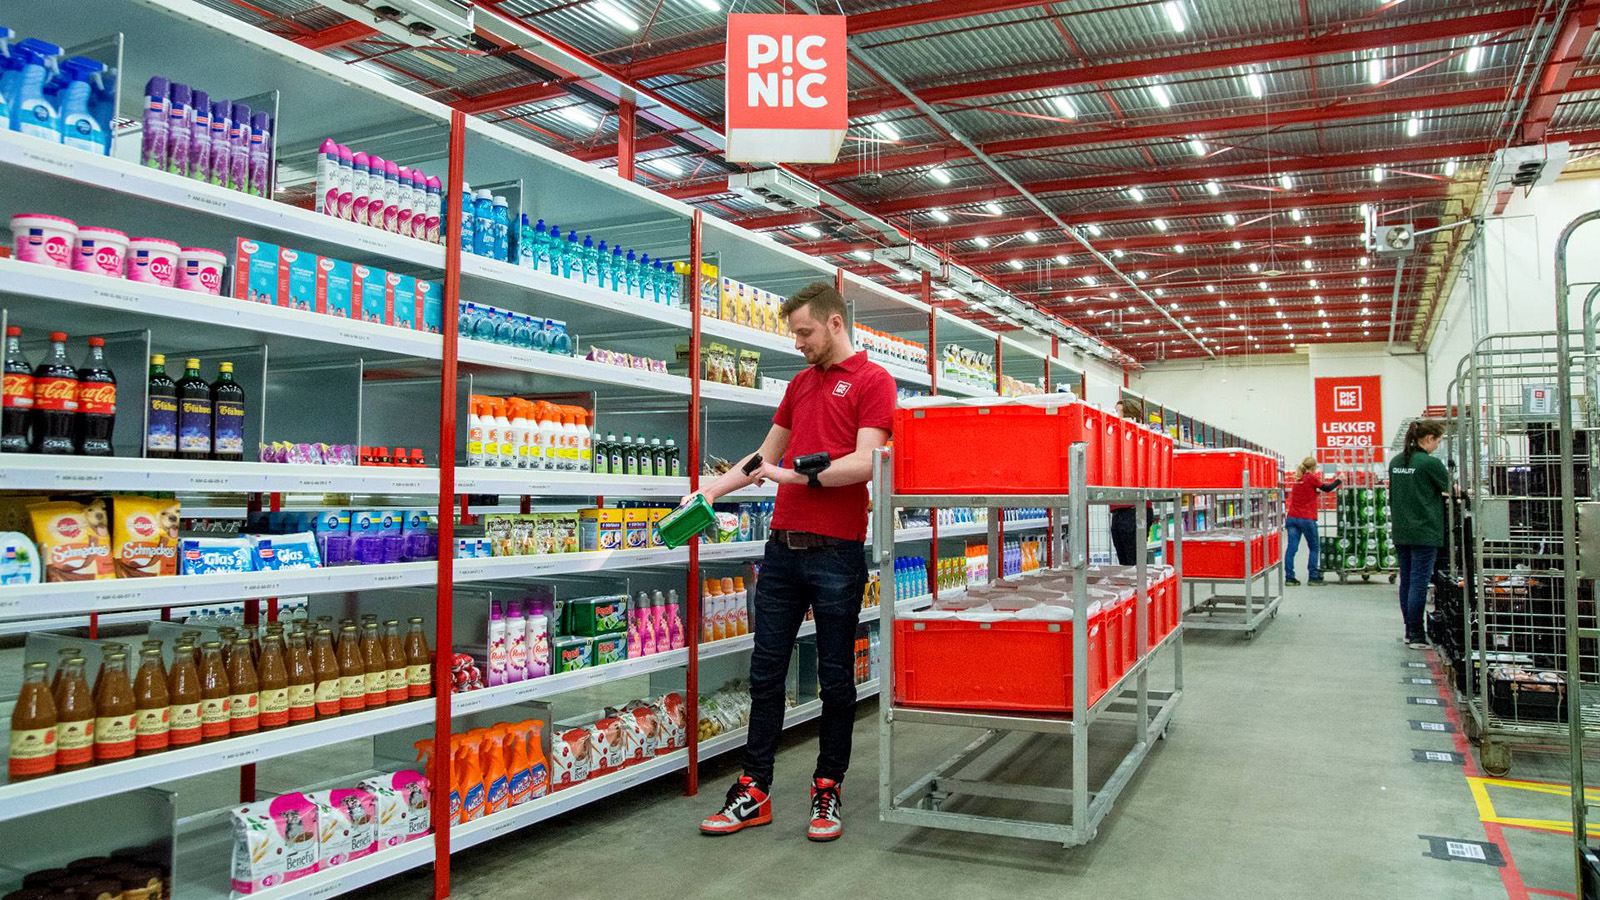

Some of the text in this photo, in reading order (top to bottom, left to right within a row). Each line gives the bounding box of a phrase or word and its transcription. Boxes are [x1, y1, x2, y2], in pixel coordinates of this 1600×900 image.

[747, 34, 828, 71] PIC
[1339, 391, 1356, 399] PIC
[1322, 421, 1376, 434] LEKKER
[1326, 435, 1373, 447] BEZIG!
[277, 549, 304, 563] Glas
